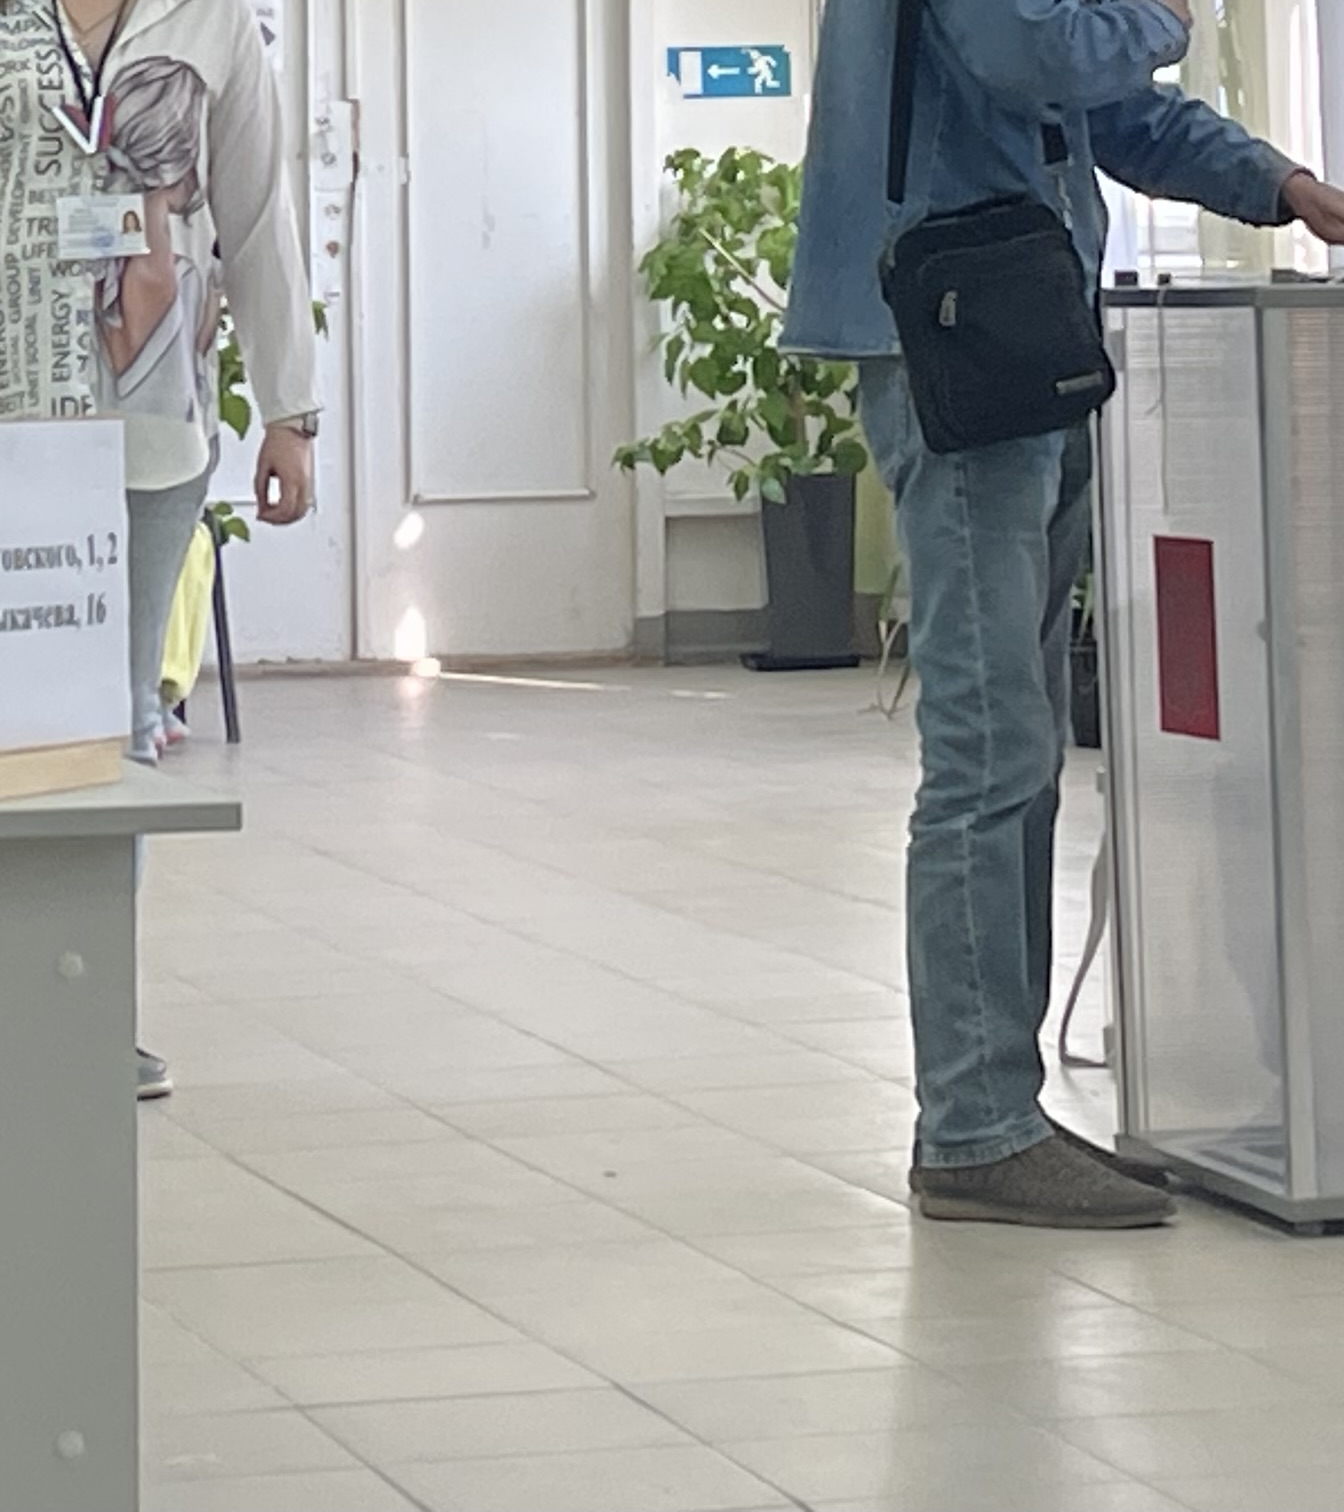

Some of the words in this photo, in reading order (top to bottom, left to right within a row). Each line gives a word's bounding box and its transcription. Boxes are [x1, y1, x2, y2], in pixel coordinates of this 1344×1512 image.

[51, 290, 73, 383] ENERGY
[86, 533, 104, 572] 1,
[107, 531, 119, 565] 2
[87, 592, 106, 626] 16
